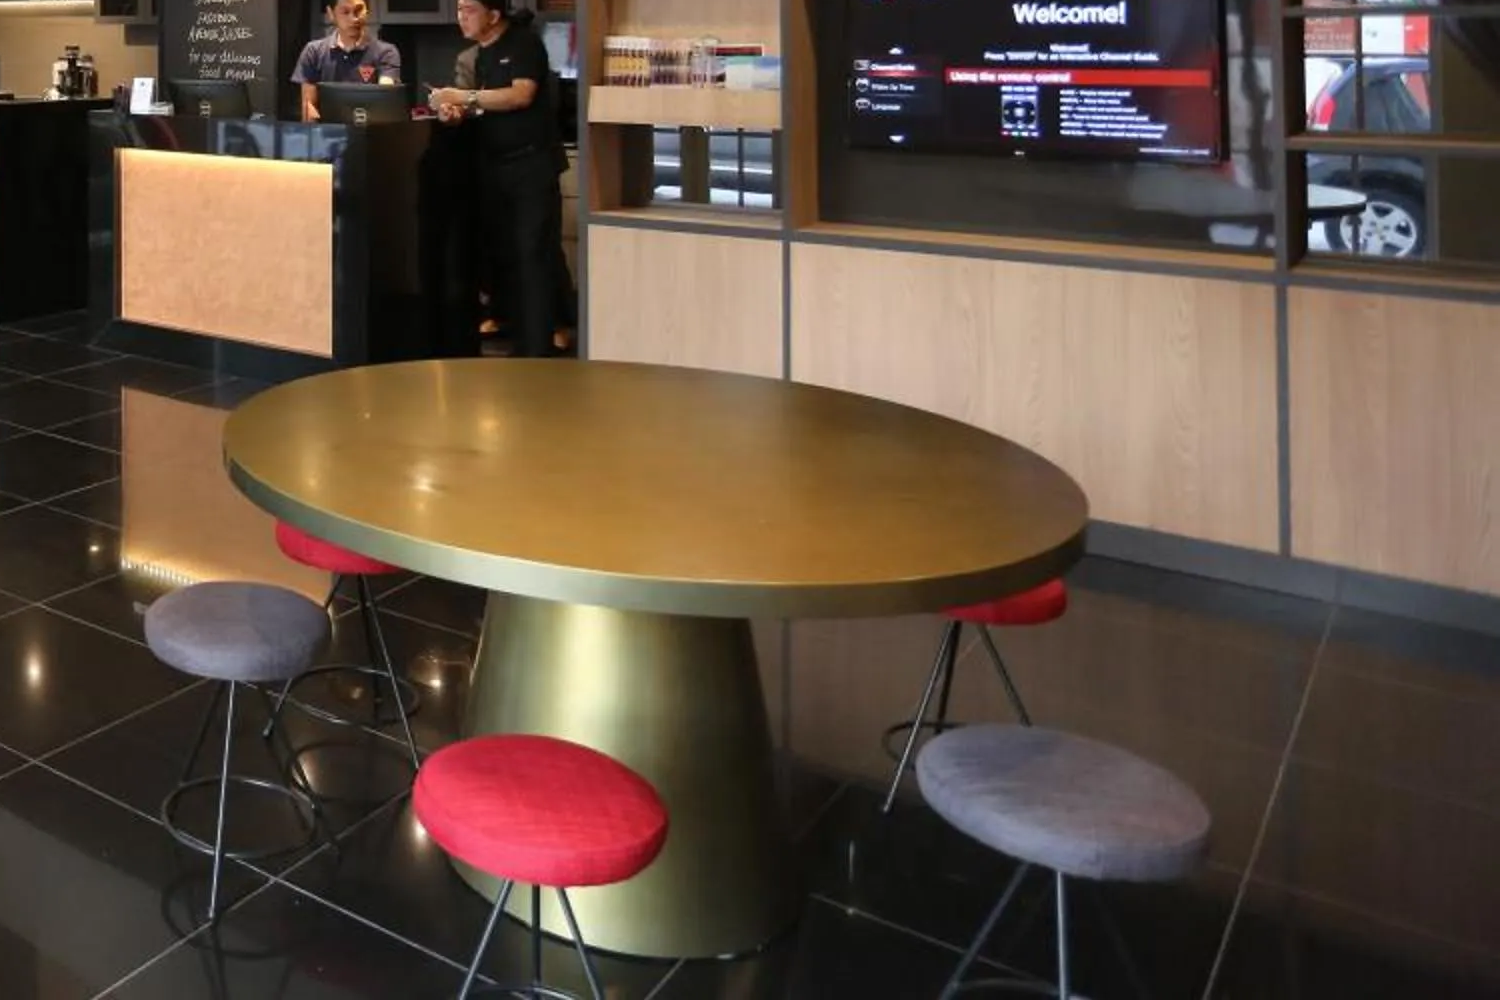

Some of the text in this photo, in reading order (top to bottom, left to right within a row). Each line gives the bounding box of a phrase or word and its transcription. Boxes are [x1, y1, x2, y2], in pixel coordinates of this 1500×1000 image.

[1012, 0, 1127, 25] Welcome!
[979, 72, 996, 82] the
[997, 72, 1033, 83] remote
